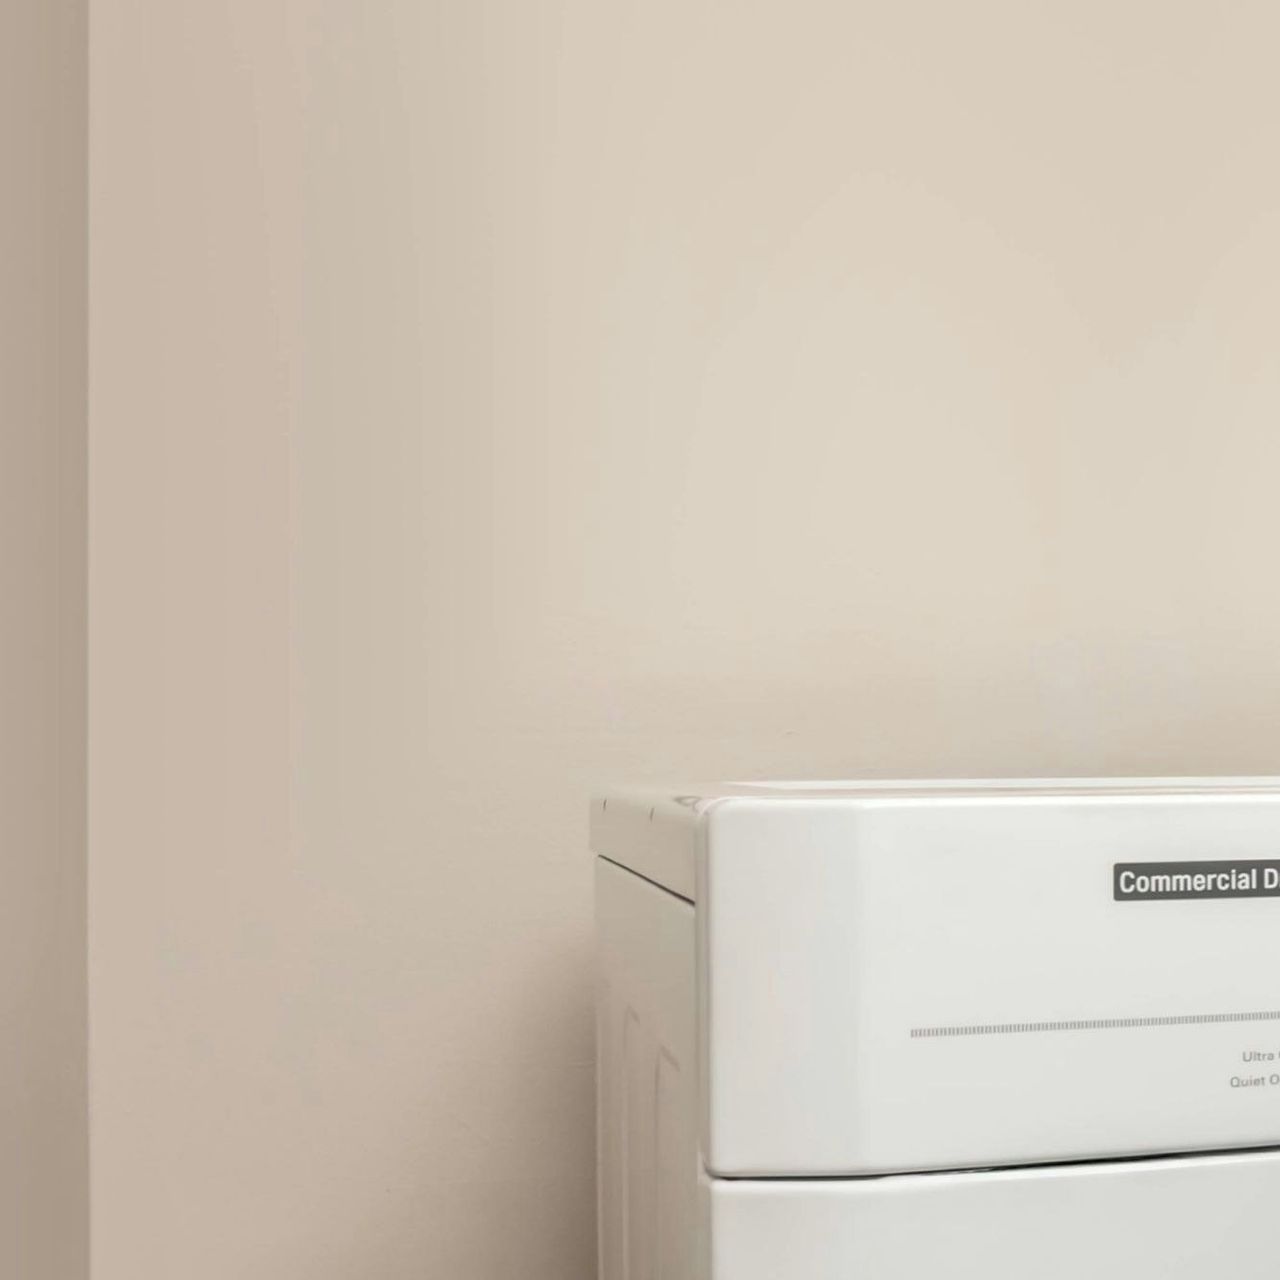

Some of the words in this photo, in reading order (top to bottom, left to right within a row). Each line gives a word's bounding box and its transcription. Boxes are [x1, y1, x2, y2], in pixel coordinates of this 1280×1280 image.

[1119, 869, 1257, 893] Commercial
[1242, 1050, 1274, 1062] Ultra
[1230, 1076, 1265, 1088] Quiet
